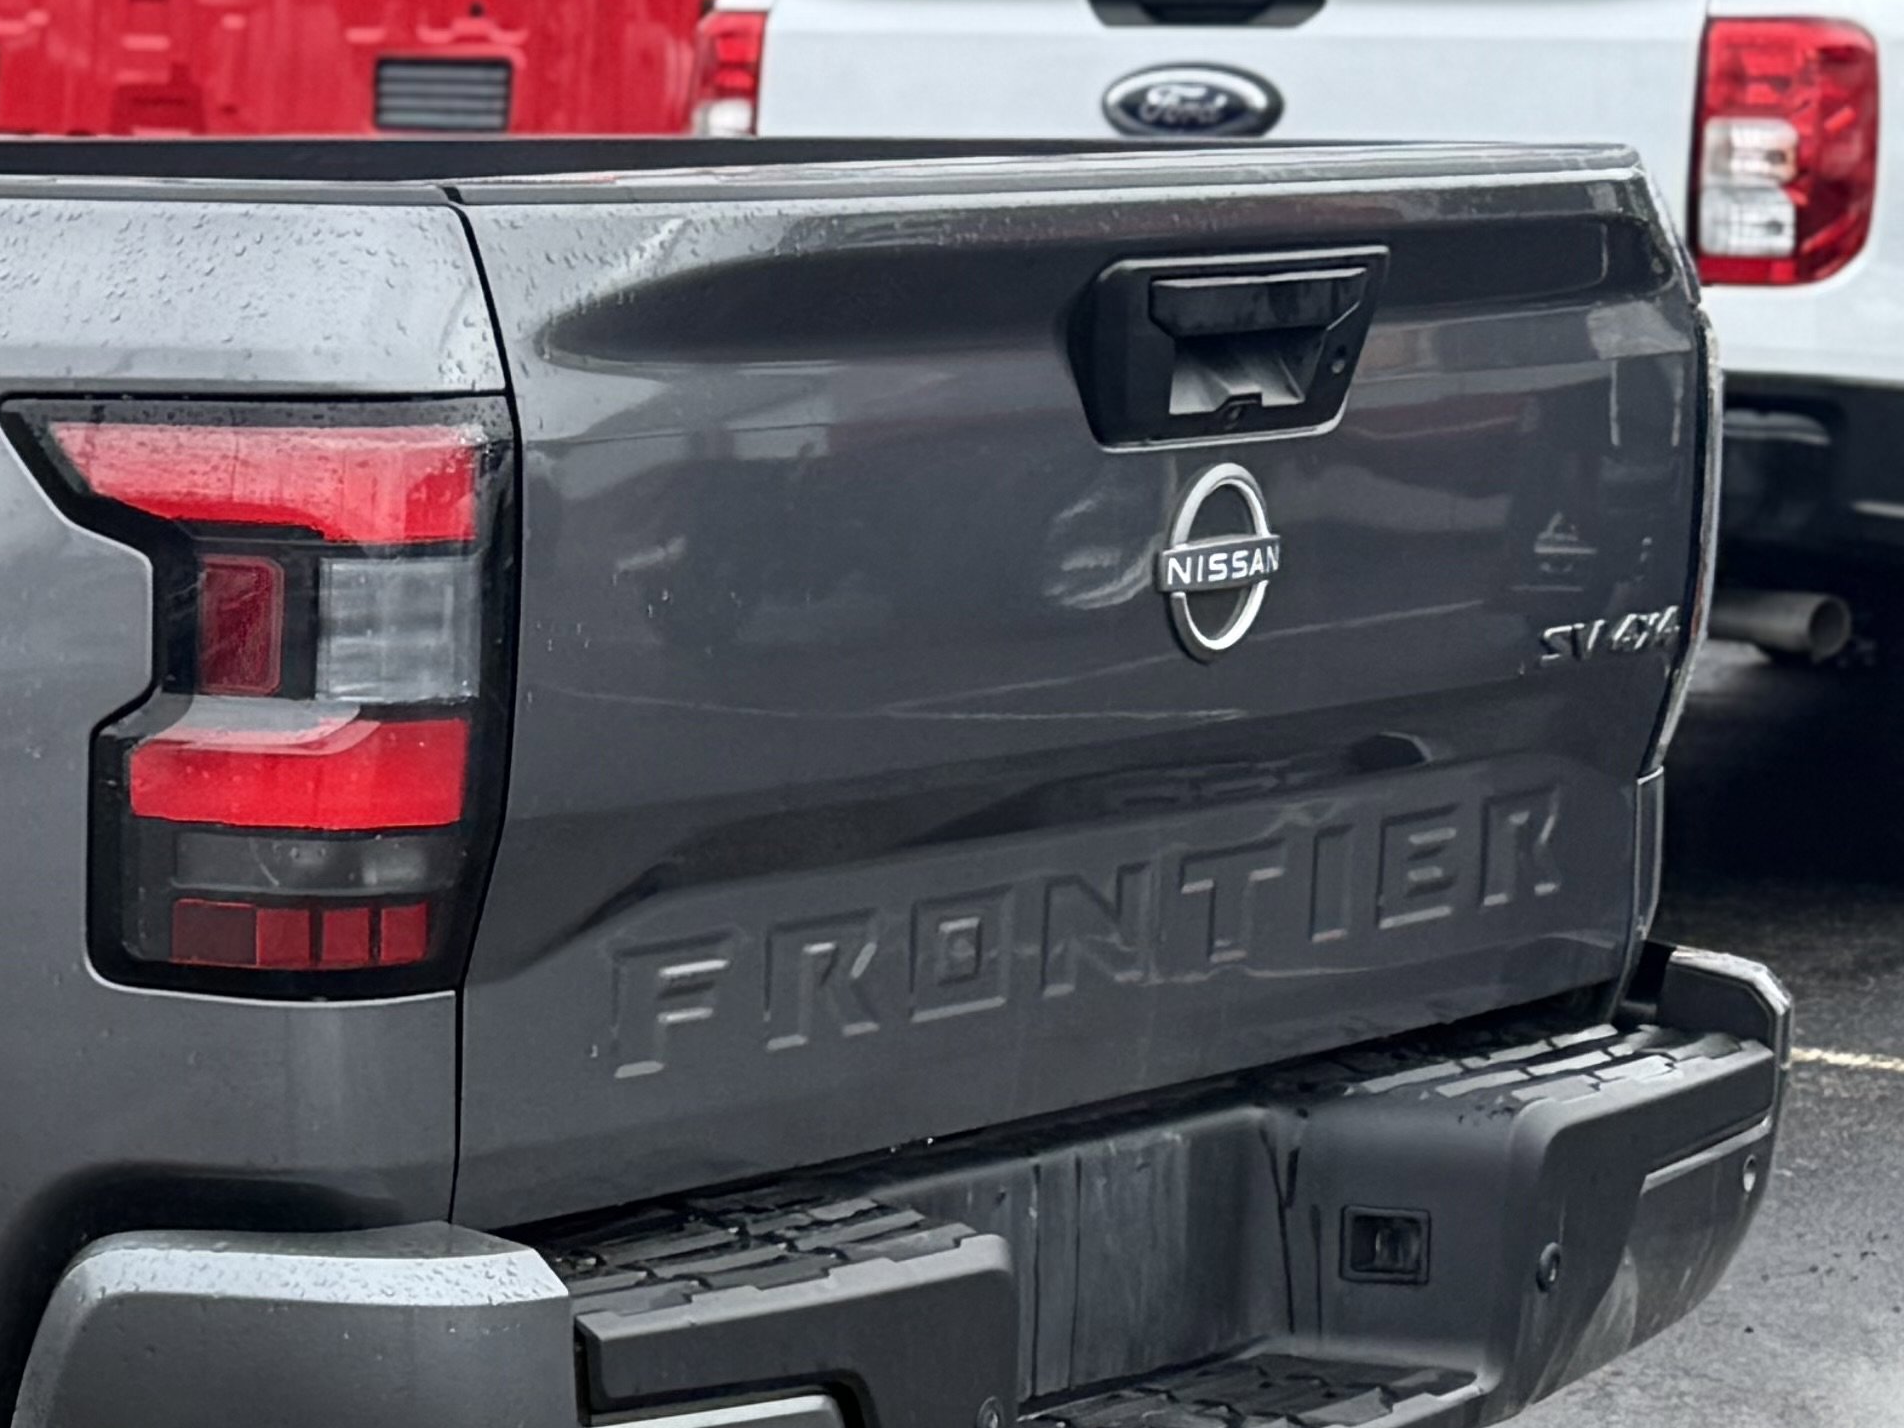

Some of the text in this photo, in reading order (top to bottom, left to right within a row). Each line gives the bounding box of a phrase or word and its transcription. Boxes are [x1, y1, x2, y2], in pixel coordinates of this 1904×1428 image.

[1137, 82, 1228, 126] Ford
[1166, 544, 1280, 586] NISSAN
[1541, 619, 1605, 663] SV
[610, 786, 1562, 1077] FRONTIER
